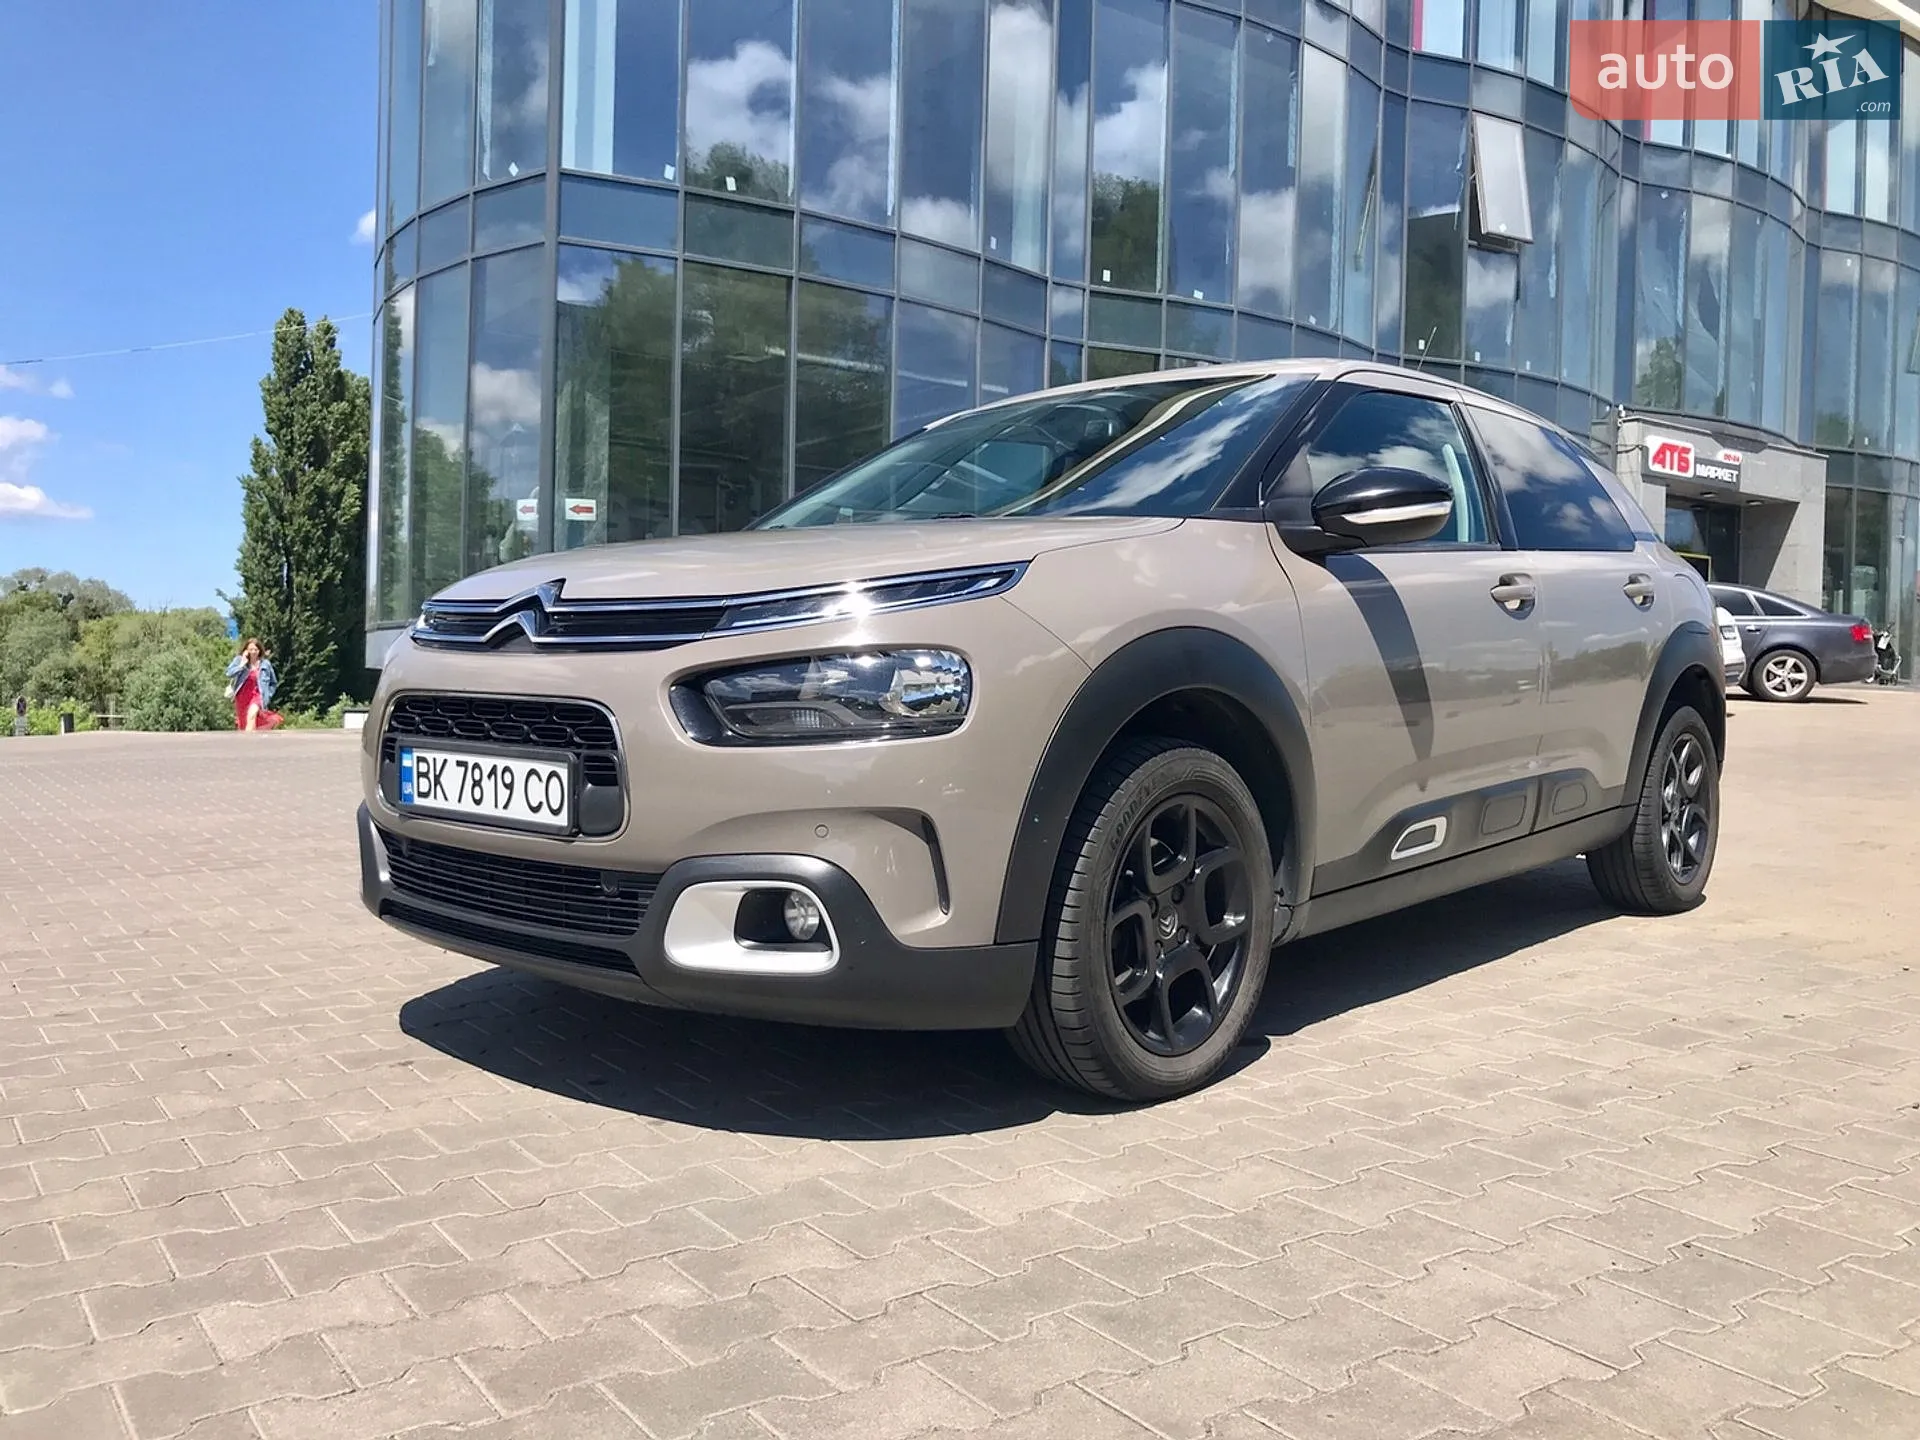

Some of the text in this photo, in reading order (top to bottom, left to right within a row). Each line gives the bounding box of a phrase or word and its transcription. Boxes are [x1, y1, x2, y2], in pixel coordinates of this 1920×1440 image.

[1652, 442, 1692, 474] АТБ
[1695, 463, 1739, 483] МАРКЕТ
[416, 755, 566, 817] BK 7819 CO
